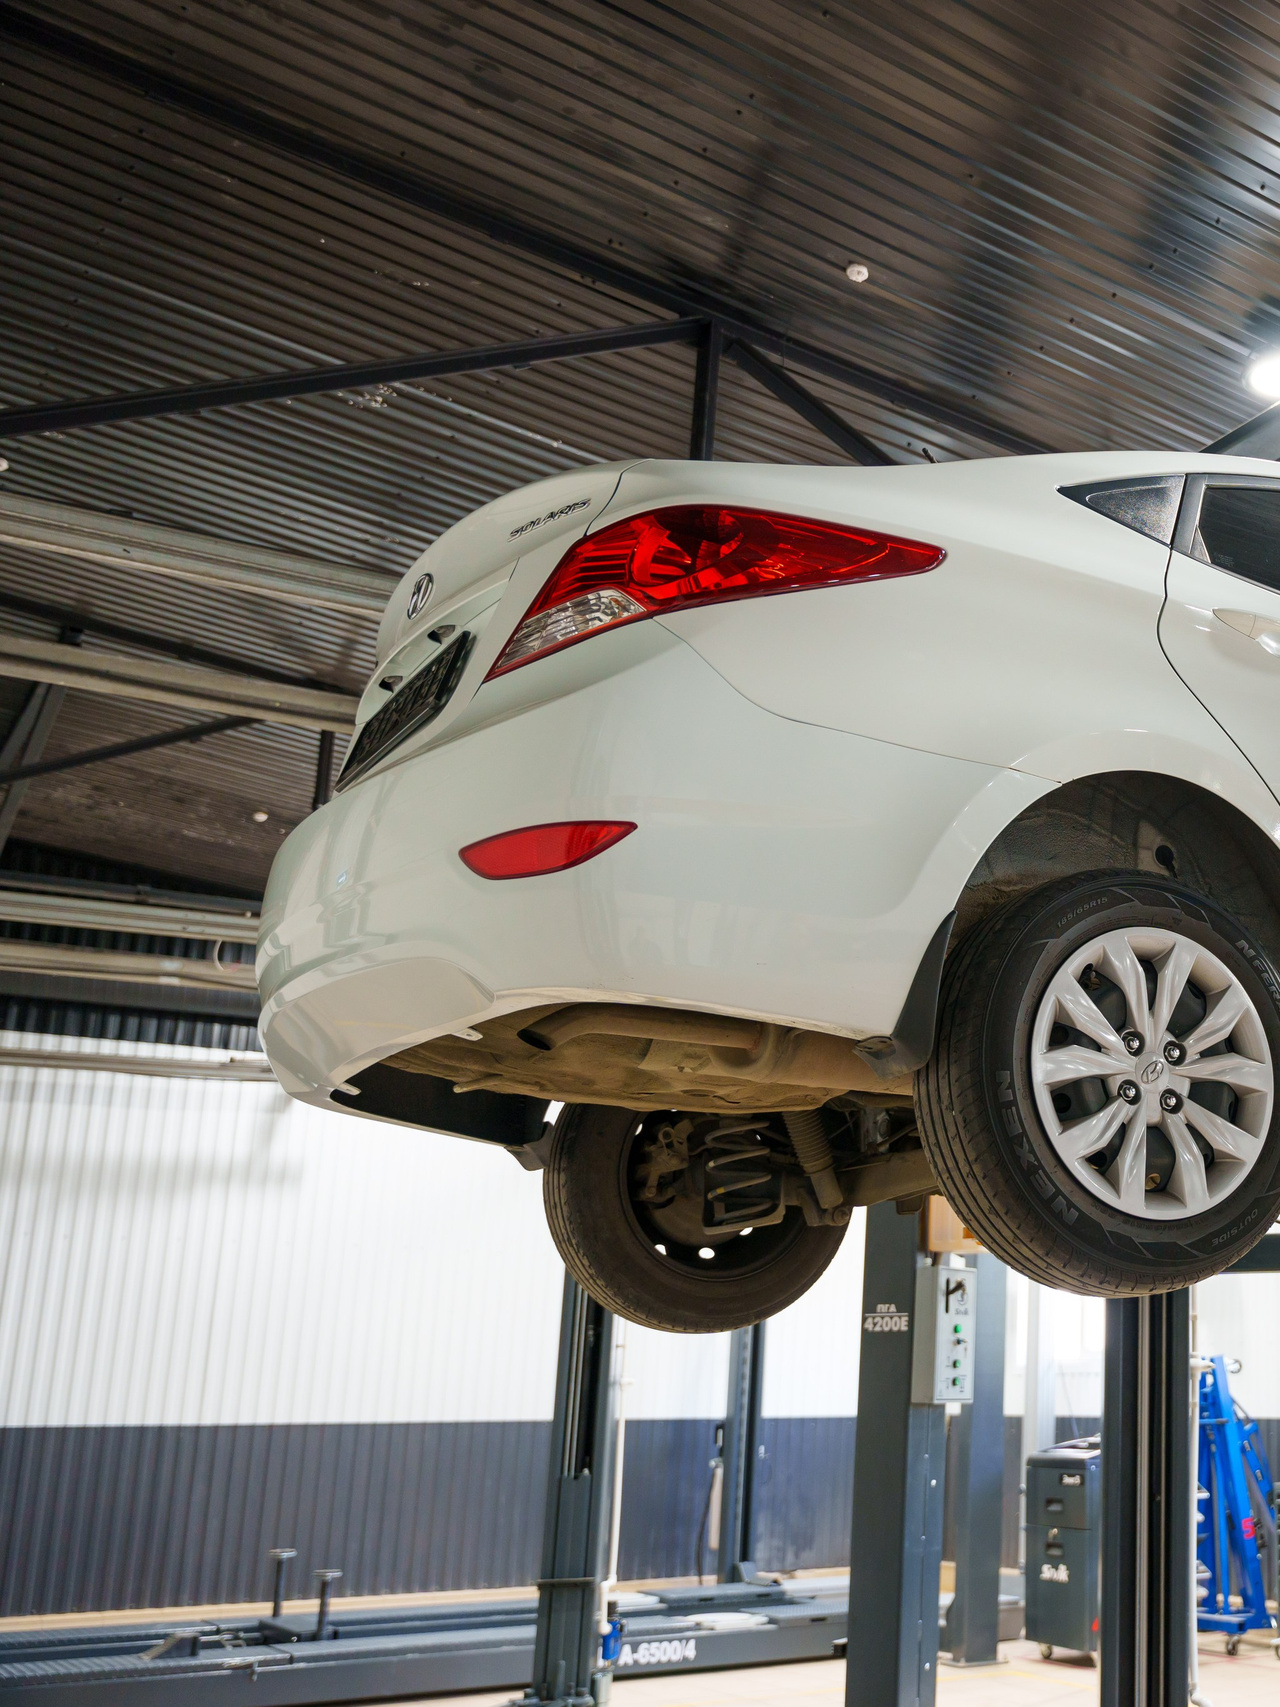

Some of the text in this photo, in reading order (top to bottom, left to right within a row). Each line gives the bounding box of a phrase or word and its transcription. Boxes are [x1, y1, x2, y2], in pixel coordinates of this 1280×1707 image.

[508, 498, 592, 542] SOLARIS
[995, 1070, 1079, 1226] NEXEN
[1211, 1208, 1258, 1247] OUTSIDE
[876, 1303, 897, 1313] ПГА
